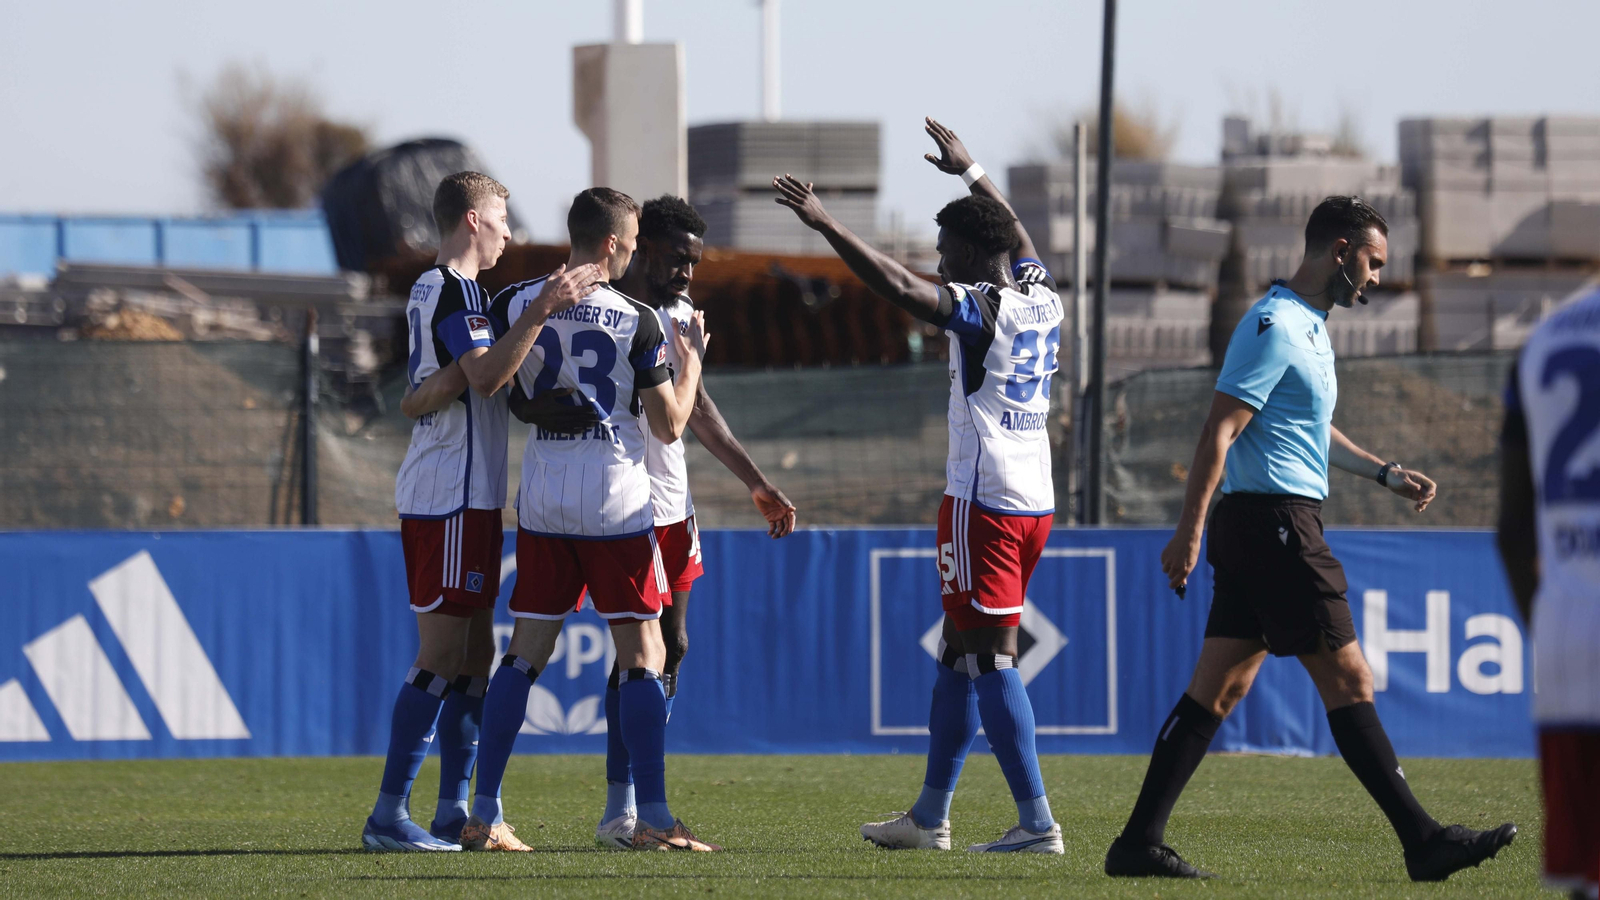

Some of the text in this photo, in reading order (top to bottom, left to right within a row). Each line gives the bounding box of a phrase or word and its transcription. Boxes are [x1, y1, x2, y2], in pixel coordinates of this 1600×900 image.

[521, 299, 624, 329] HBURGER SV
[530, 325, 617, 421] 23
[936, 542, 956, 582] 5
[1363, 589, 1537, 695] Ha
